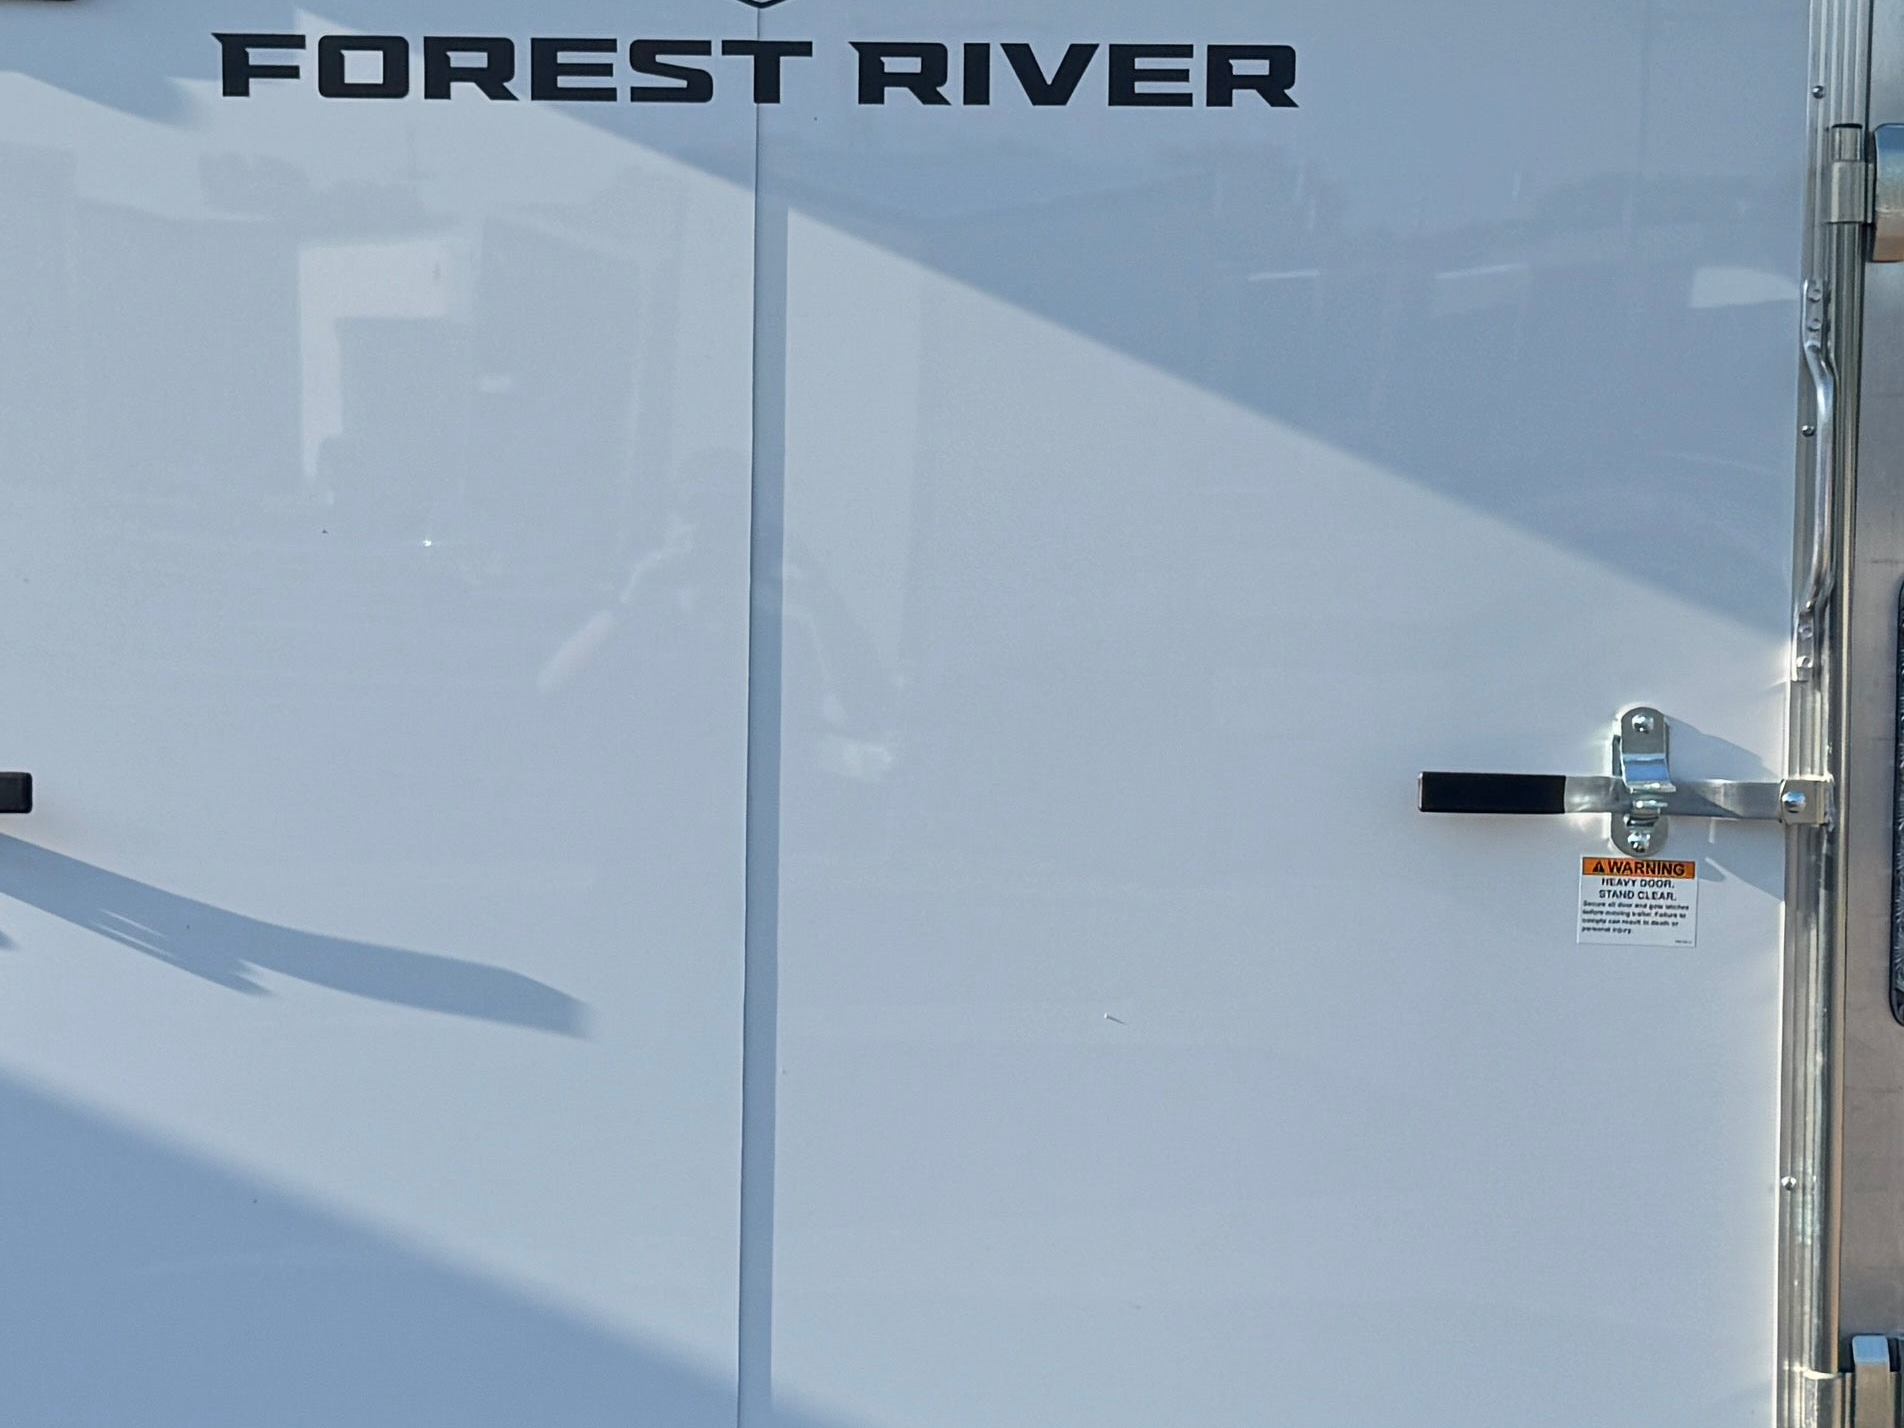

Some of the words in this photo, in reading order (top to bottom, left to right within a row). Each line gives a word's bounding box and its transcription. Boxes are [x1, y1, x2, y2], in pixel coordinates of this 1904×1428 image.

[210, 32, 814, 105] FOREST
[850, 40, 1300, 109] RIVER
[1608, 860, 1685, 876] WARNING
[1601, 878, 1637, 888] HEAVY
[1599, 889, 1634, 899] STAND
